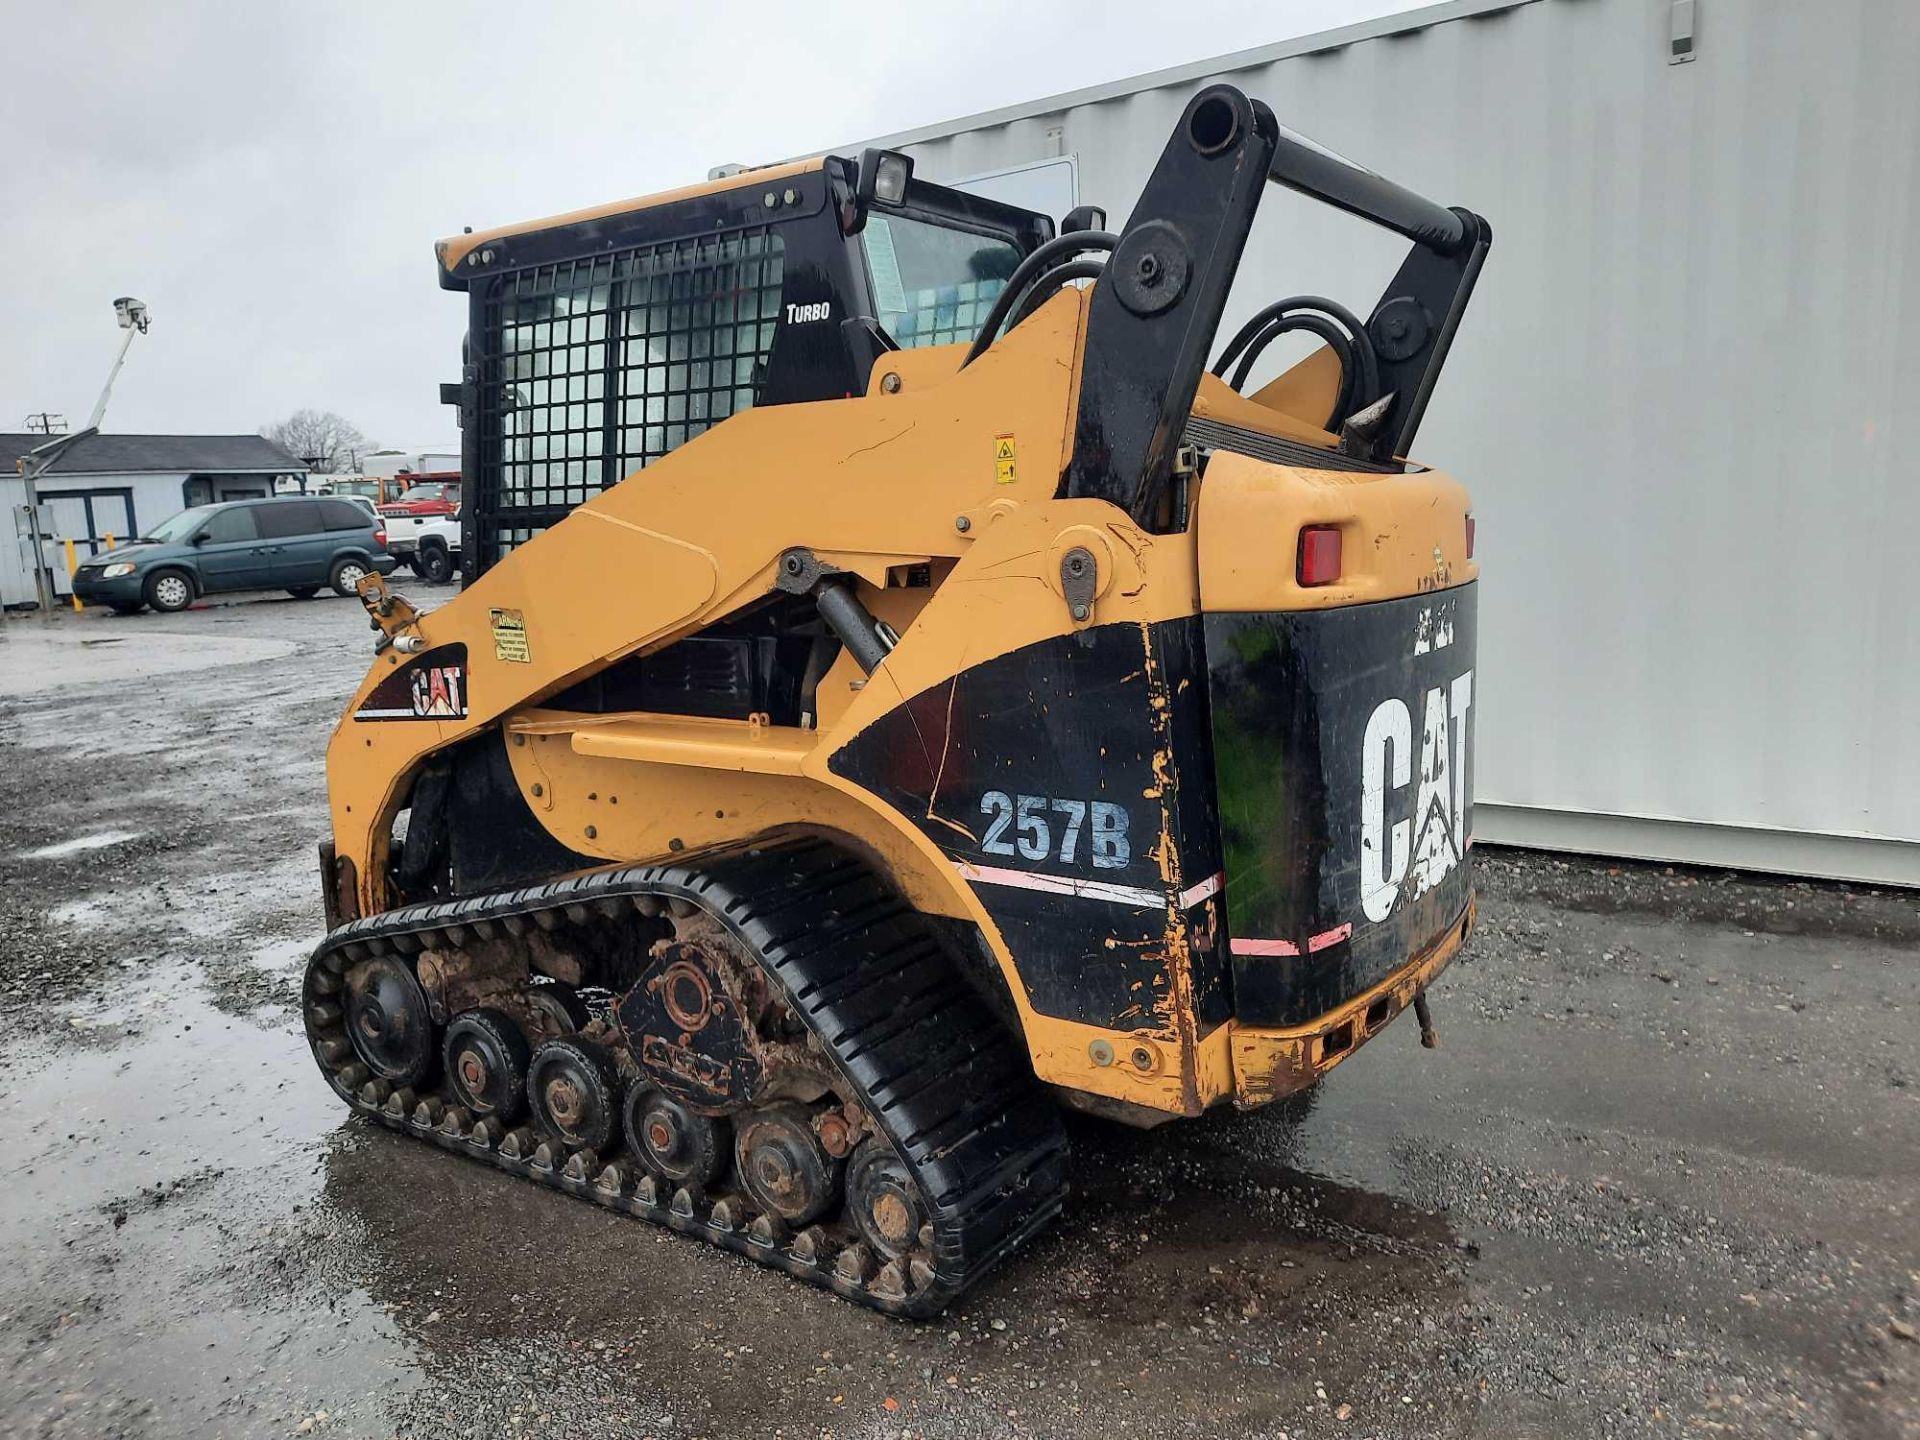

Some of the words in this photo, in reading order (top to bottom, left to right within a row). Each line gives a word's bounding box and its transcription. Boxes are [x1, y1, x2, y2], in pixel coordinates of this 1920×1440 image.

[786, 301, 830, 325] TURBO
[410, 667, 462, 716] CAT
[1360, 668, 1473, 924] CAT
[979, 790, 1132, 869] 257B
